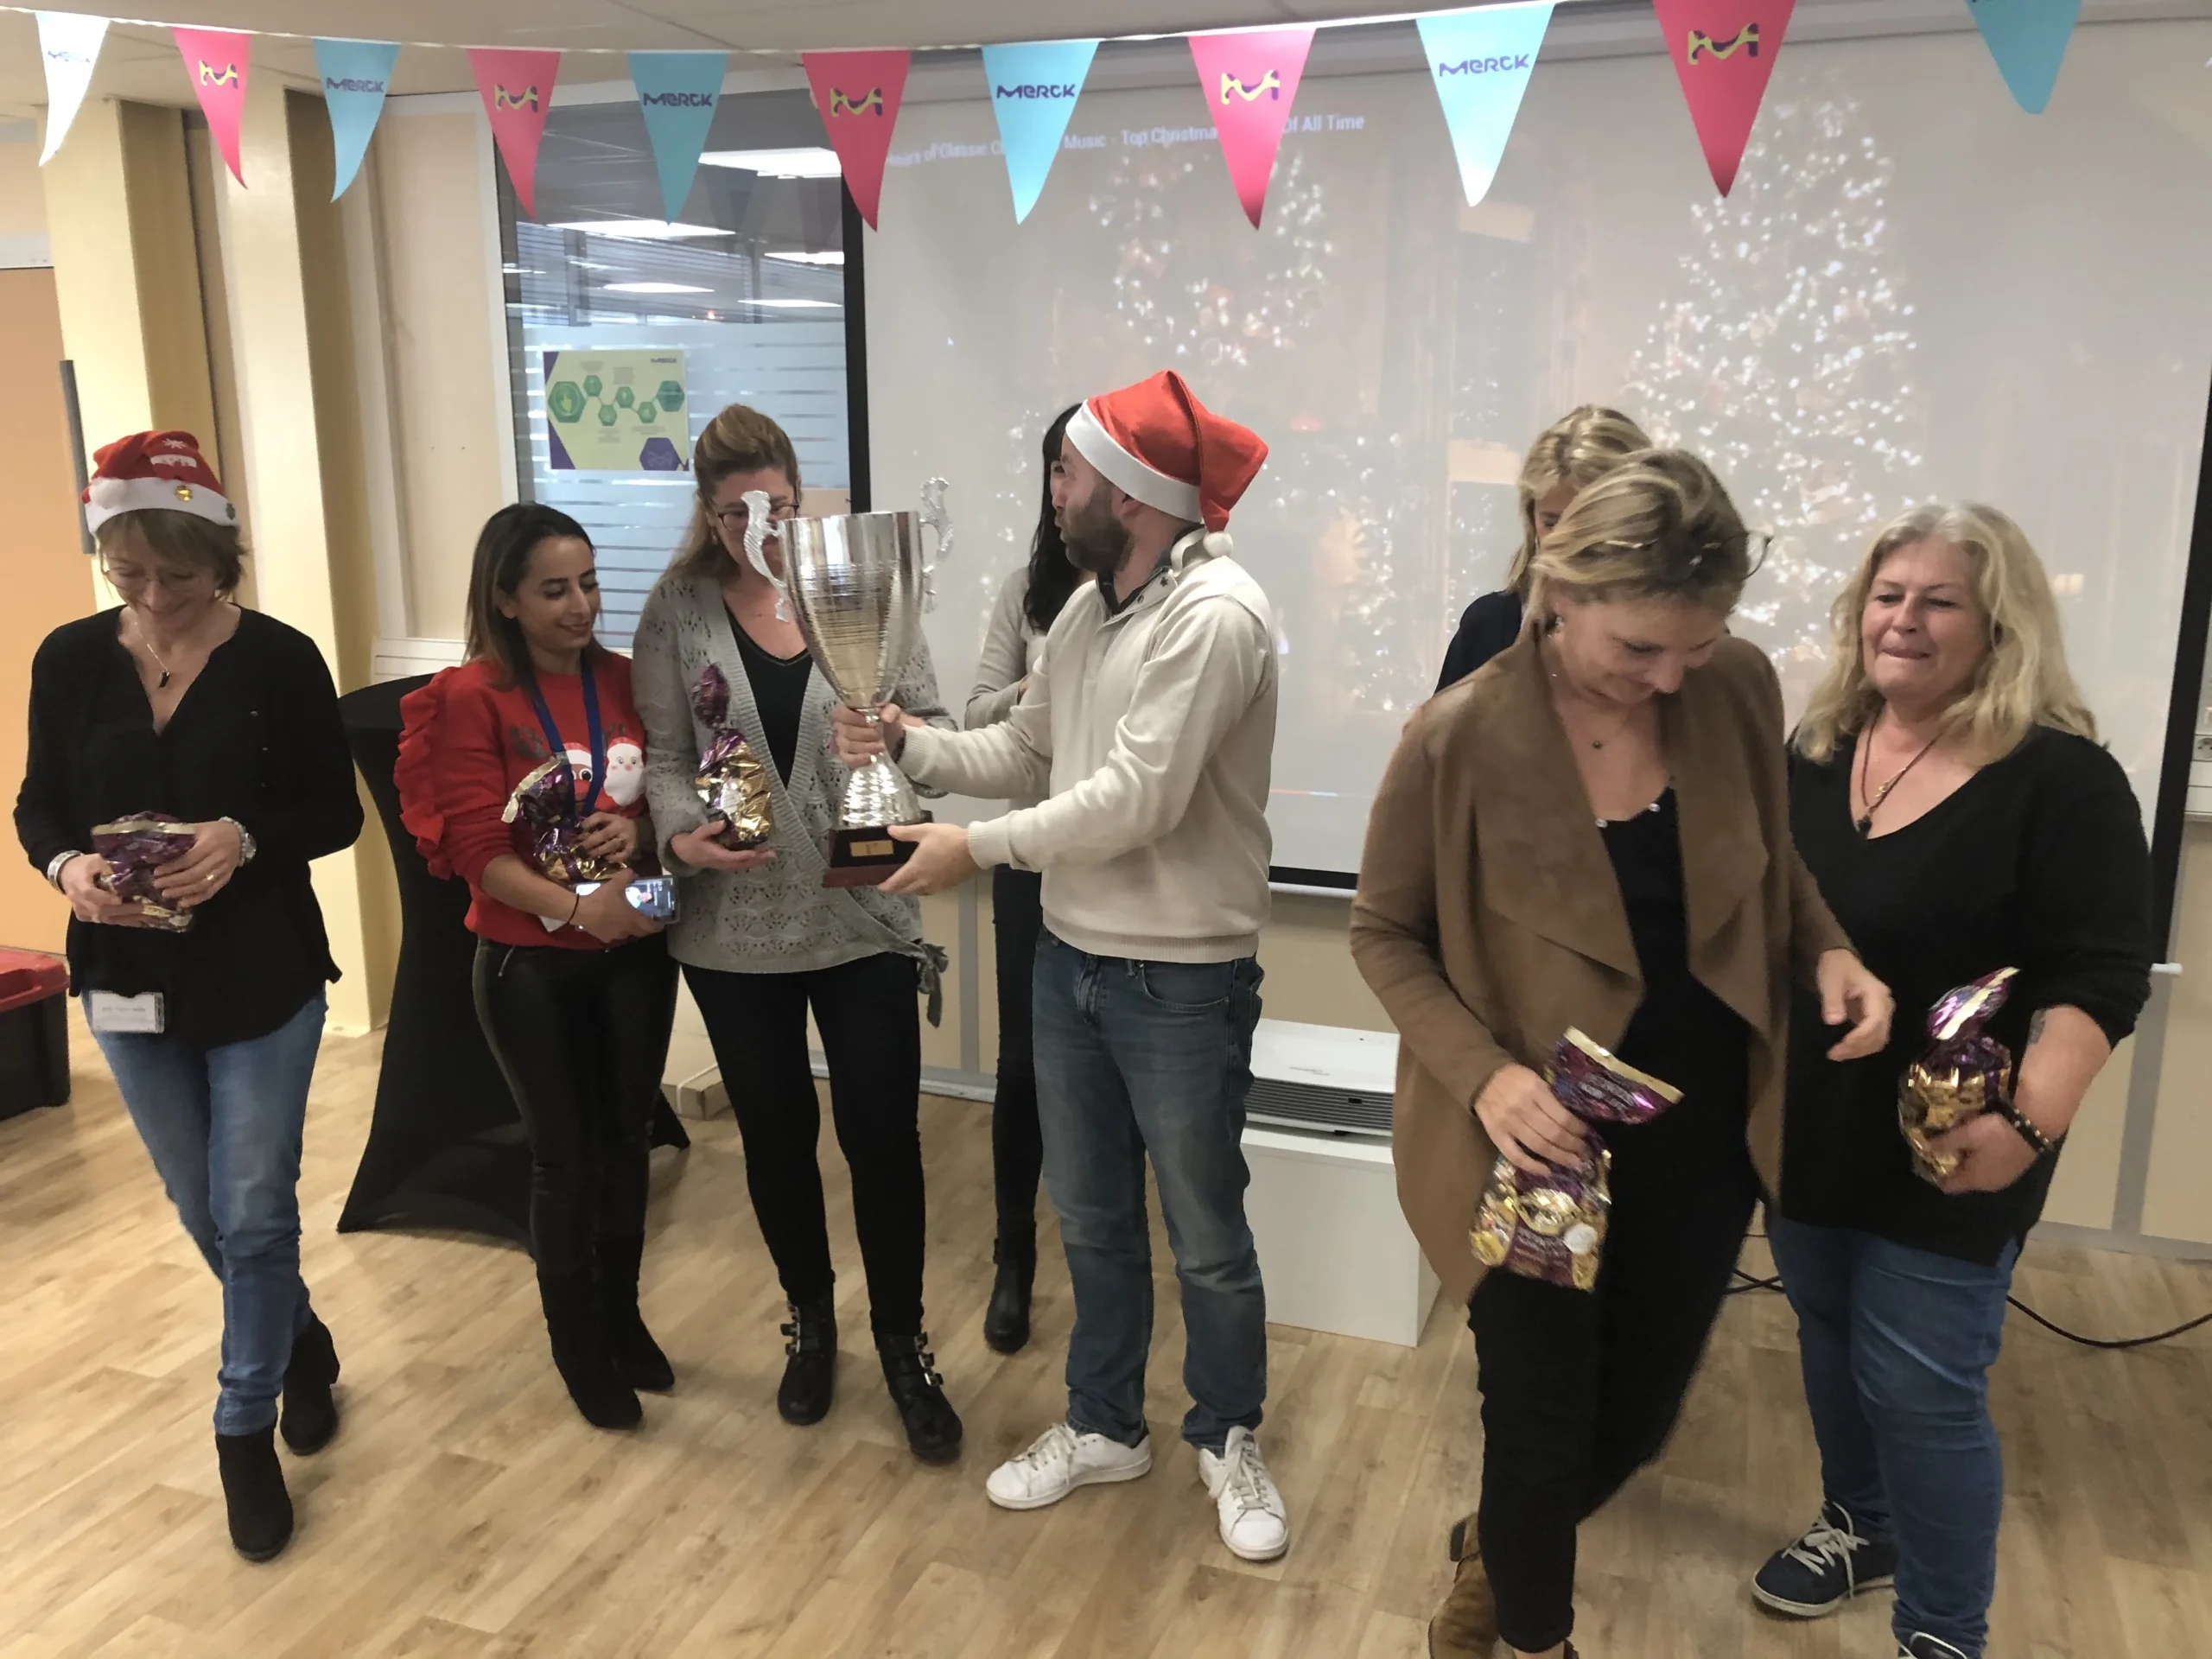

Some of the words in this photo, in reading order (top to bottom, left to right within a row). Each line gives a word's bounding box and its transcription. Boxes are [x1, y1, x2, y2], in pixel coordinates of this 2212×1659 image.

[1064, 133, 1107, 149] Music
[1120, 129, 1148, 149] Top
[1150, 126, 1219, 146] Christma
[1301, 113, 1323, 133] All
[1325, 113, 1366, 132] Time
